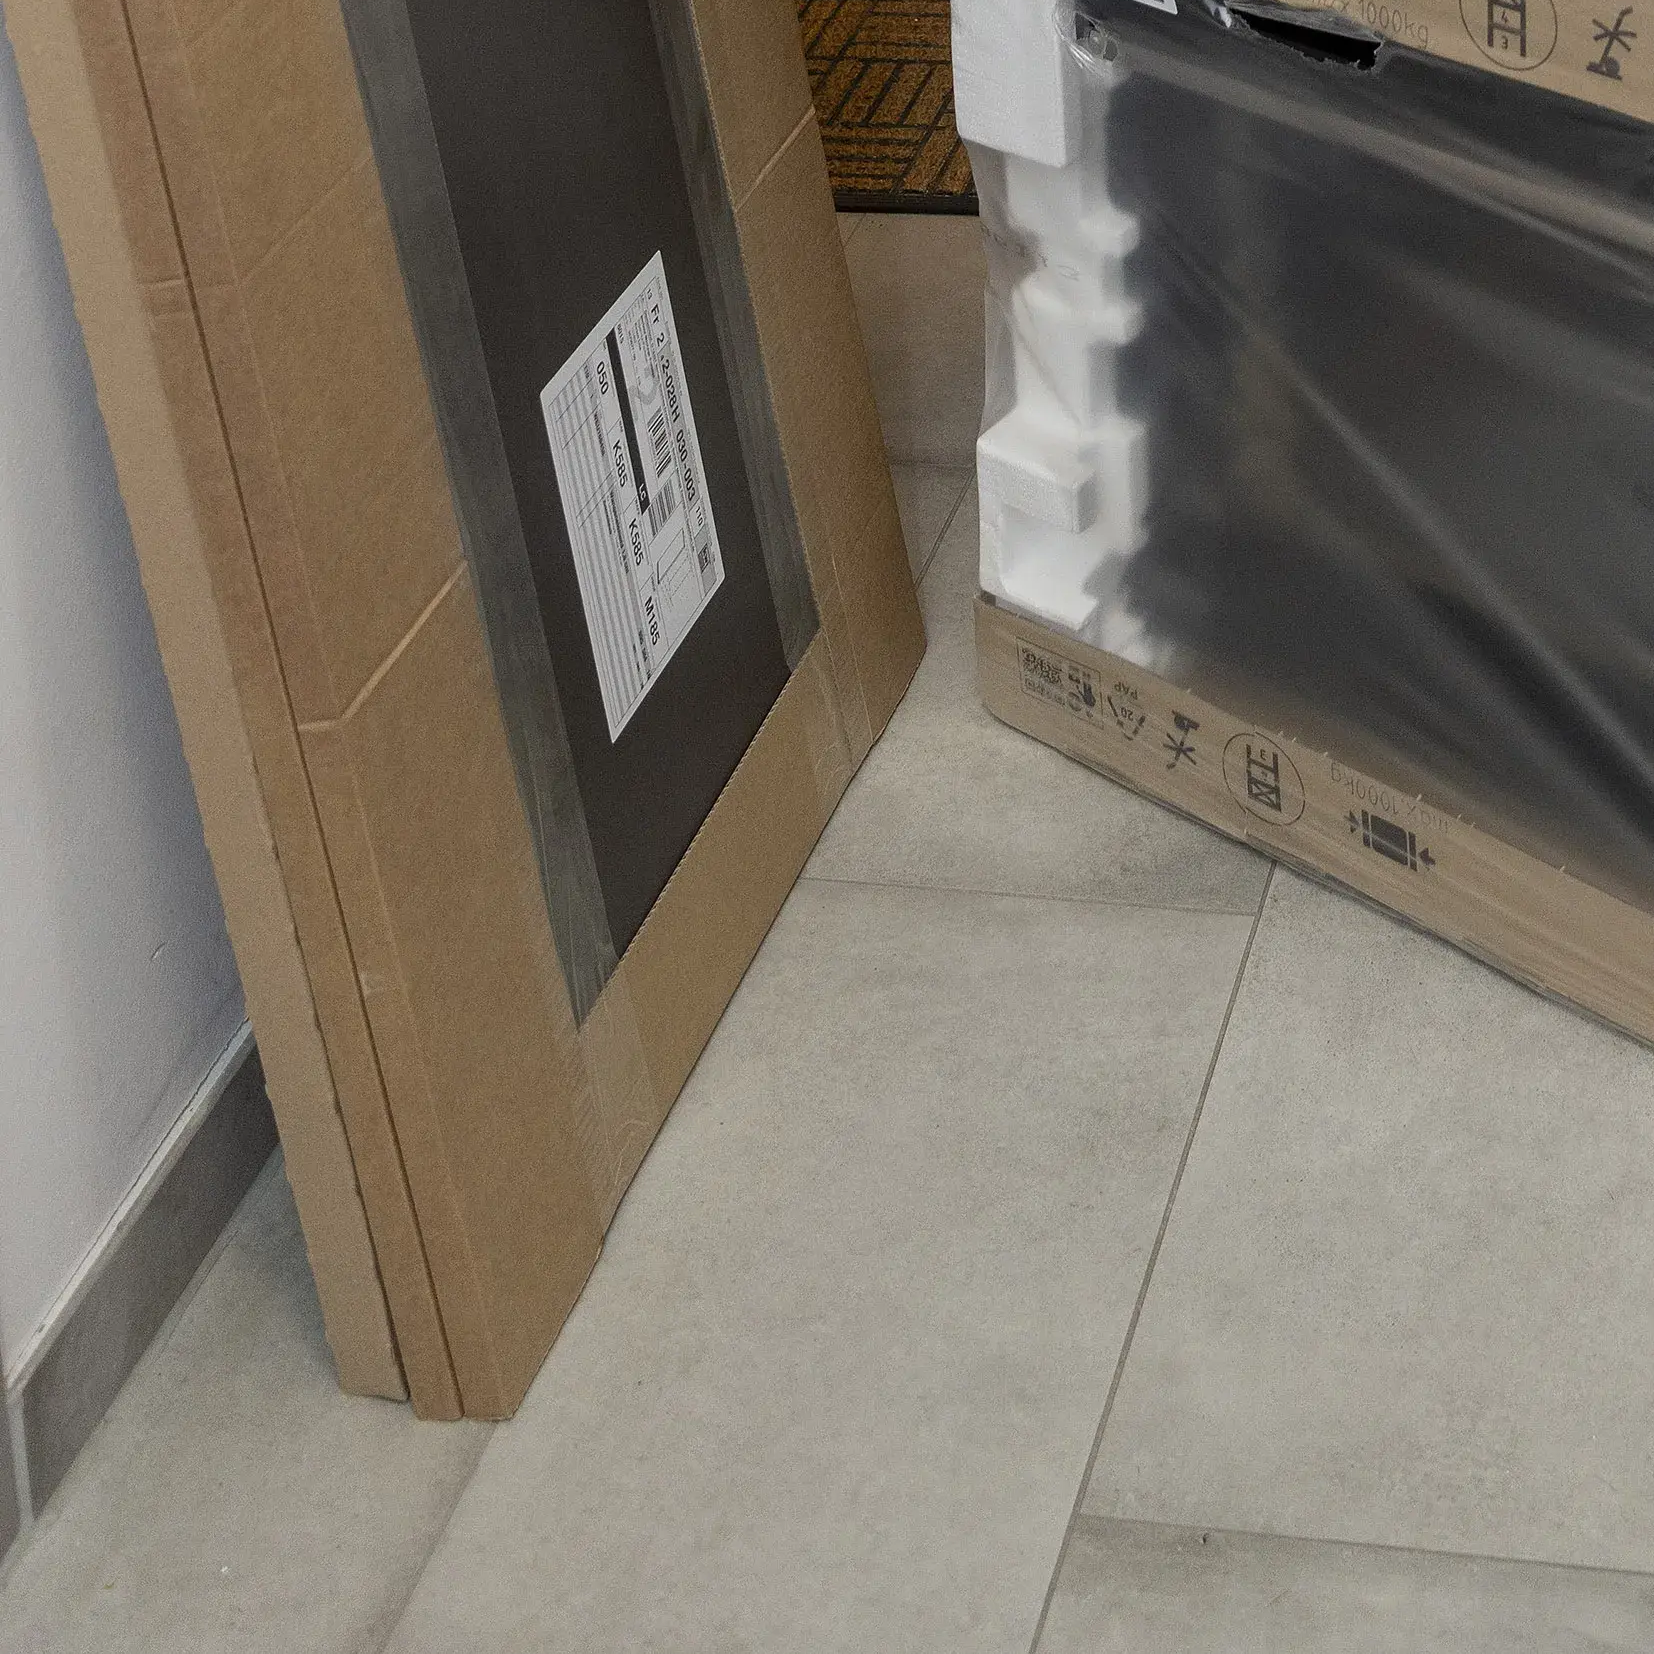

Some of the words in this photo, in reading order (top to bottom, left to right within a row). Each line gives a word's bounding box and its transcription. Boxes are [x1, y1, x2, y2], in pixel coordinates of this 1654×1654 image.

[1358, 0, 1429, 50] 1000kg
[650, 301, 661, 328] Fr
[656, 329, 665, 347] 2
[675, 427, 696, 503] 030-003
[595, 358, 609, 397] 050
[611, 437, 628, 490] K585
[628, 516, 644, 568] K585
[643, 594, 660, 648] M185
[638, 481, 646, 503] LC
